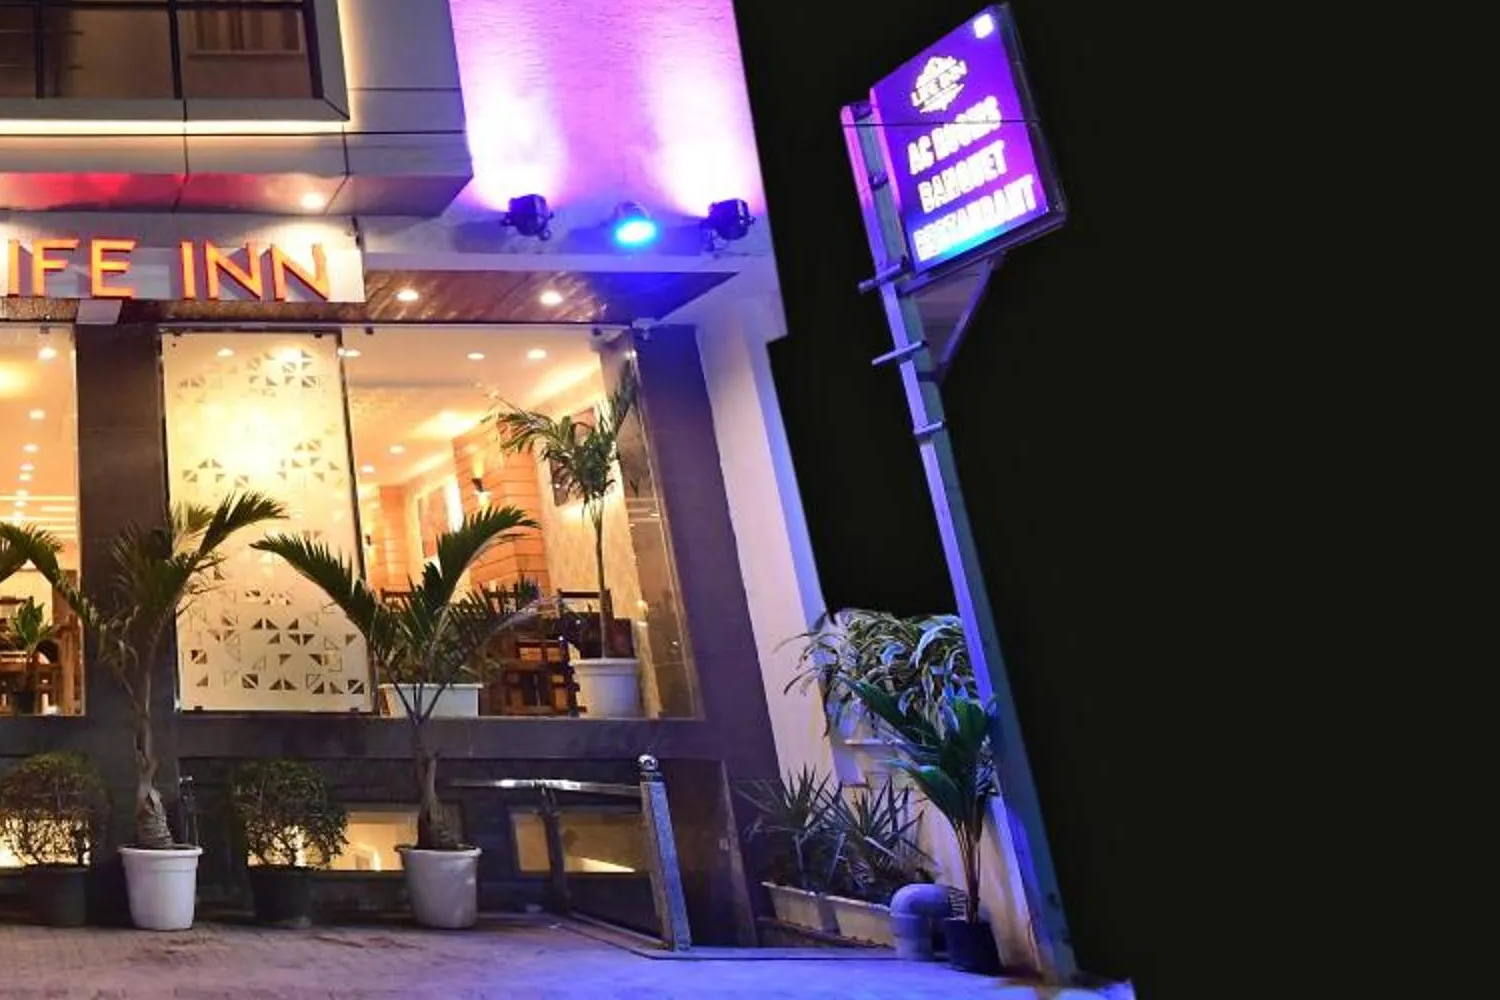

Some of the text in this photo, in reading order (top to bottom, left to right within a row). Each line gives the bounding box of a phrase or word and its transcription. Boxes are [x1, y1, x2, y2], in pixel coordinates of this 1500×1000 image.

[908, 95, 1002, 175] AC ROOMS
[918, 139, 1008, 214] BANQUET
[913, 174, 1036, 261] RESTAURANT
[179, 239, 330, 302] INN
